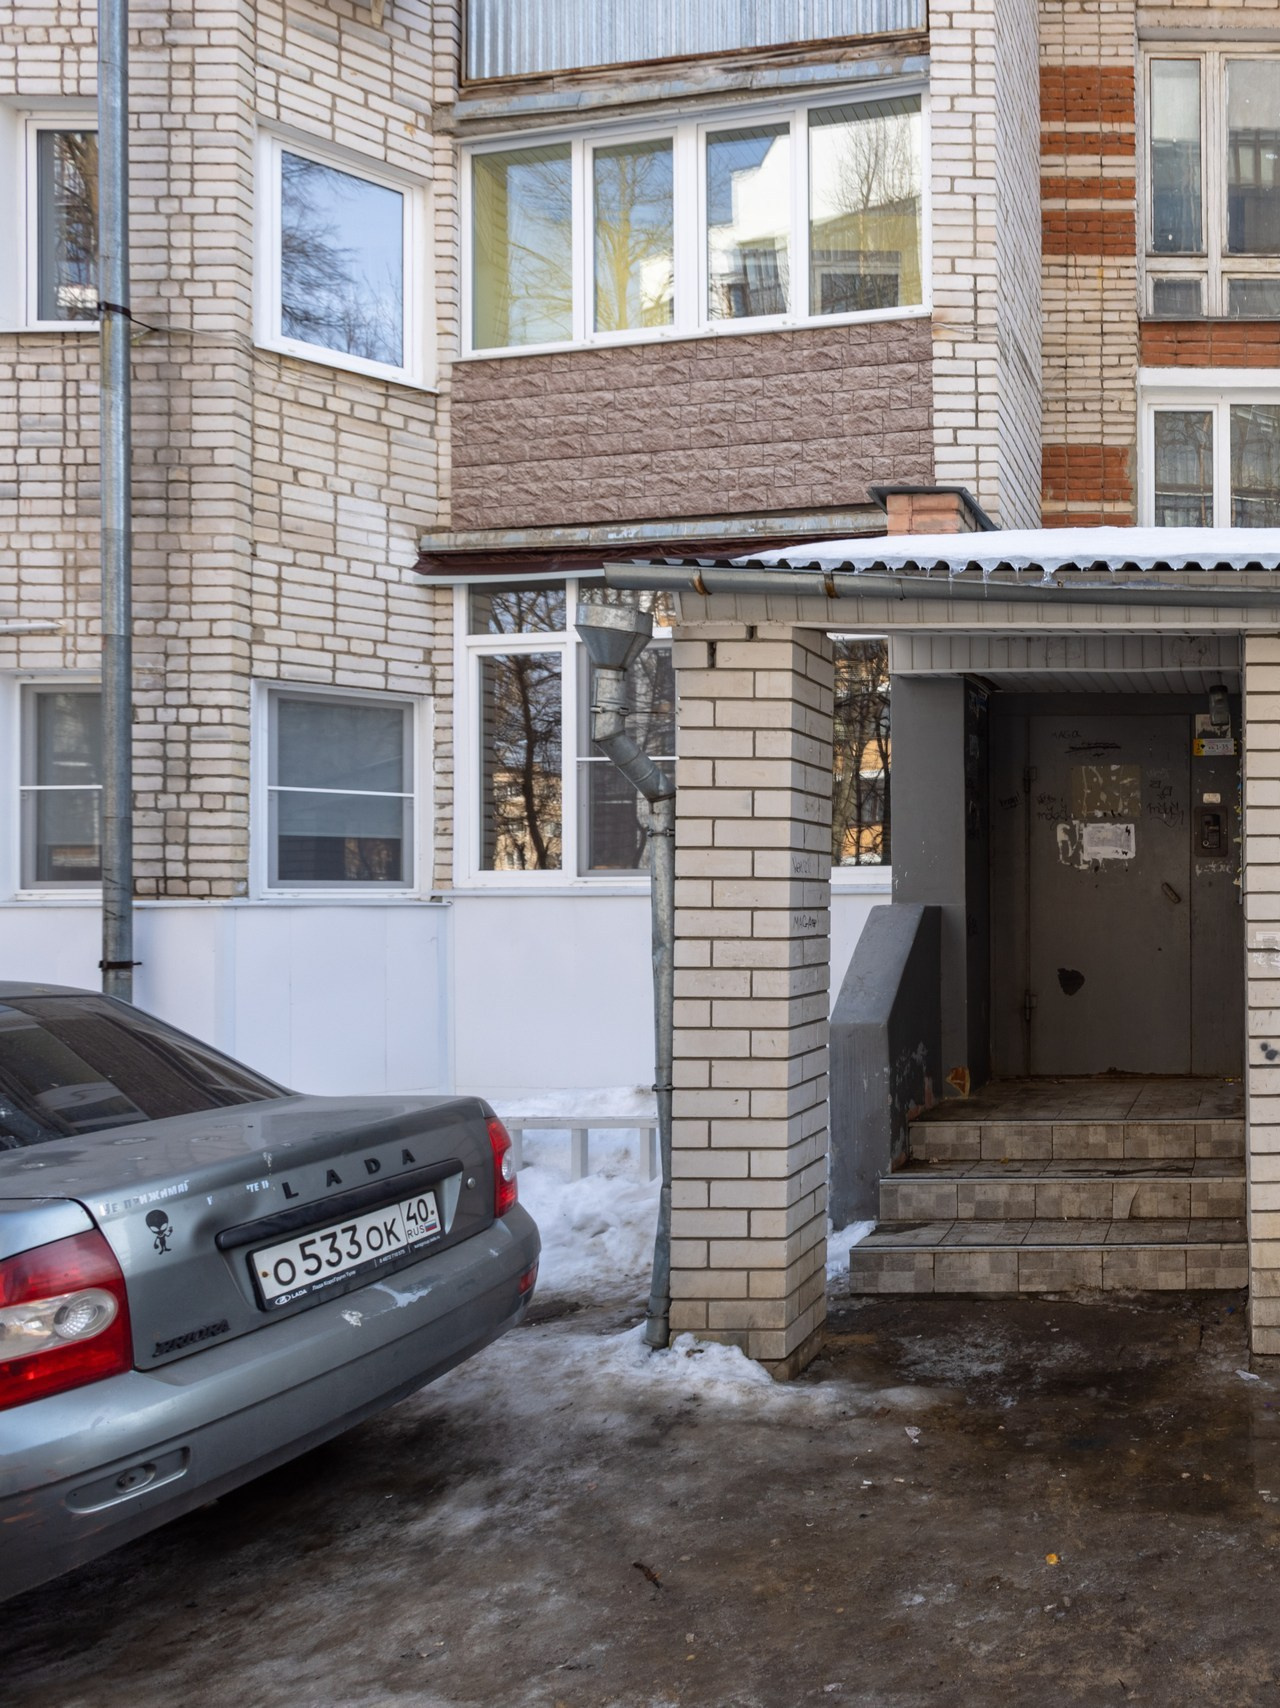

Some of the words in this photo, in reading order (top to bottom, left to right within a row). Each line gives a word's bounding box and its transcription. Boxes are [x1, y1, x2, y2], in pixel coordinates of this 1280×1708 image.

[281, 1149, 416, 1200] LADA
[406, 1198, 429, 1225] 40
[406, 1224, 425, 1240] RUS
[291, 1288, 308, 1299] LADA
